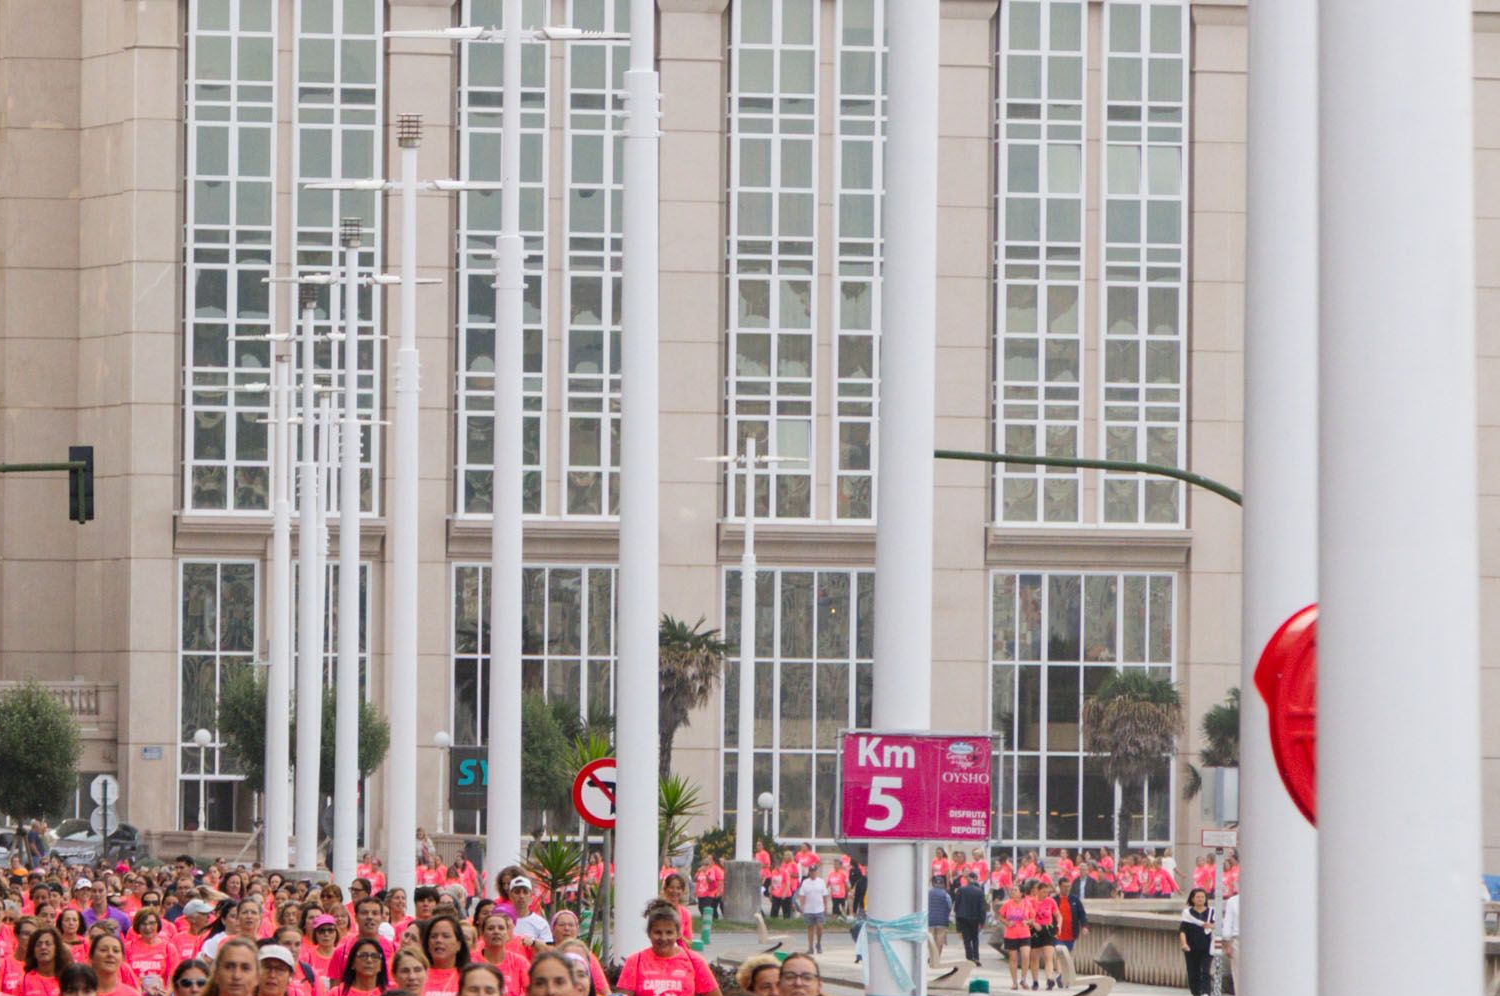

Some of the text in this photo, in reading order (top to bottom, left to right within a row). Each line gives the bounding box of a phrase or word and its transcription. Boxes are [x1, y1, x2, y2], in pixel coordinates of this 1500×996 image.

[858, 737, 915, 768] Km
[942, 771, 990, 784] OYSHO
[864, 776, 903, 831] 5
[949, 810, 987, 818] DISFRUTA
[951, 827, 987, 835] DEPORTE
[644, 980, 682, 992] CARRERA
